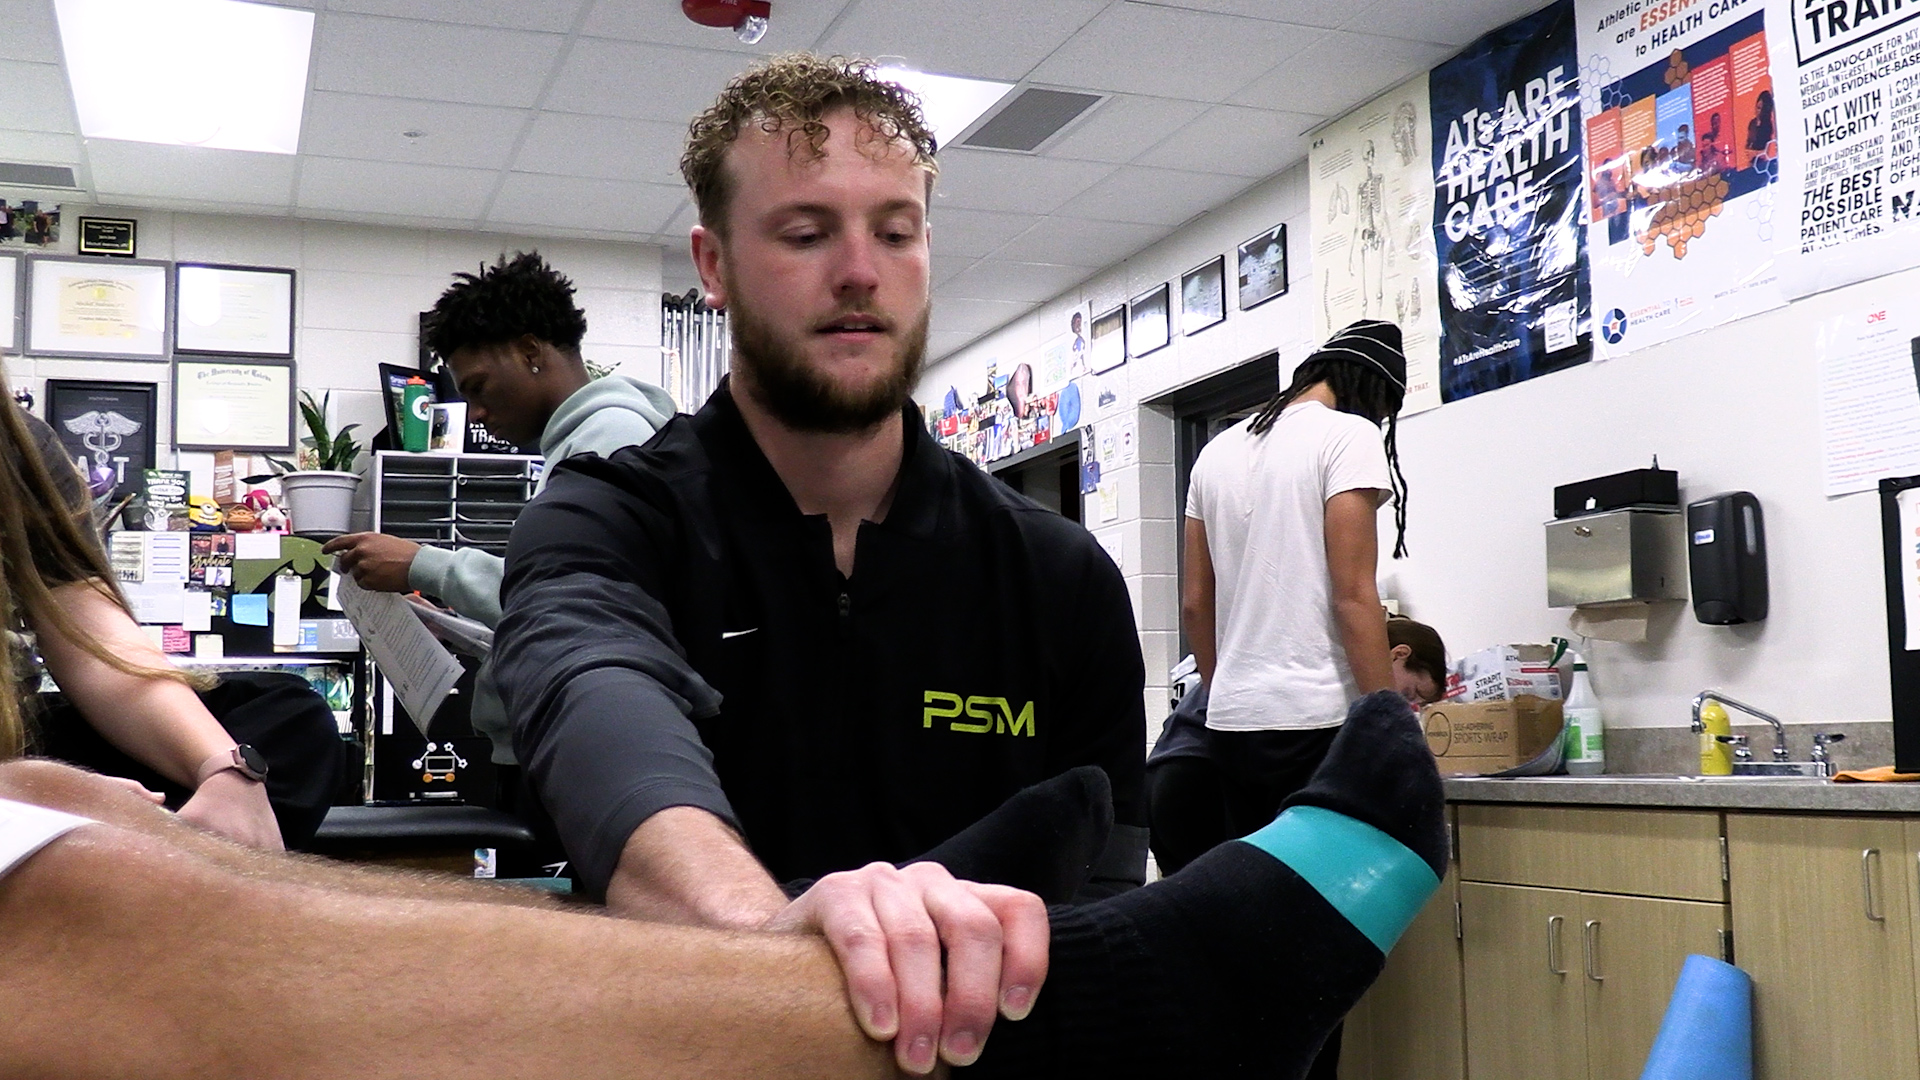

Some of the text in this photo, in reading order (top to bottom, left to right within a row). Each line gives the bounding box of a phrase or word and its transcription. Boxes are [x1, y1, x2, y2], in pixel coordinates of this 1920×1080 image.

[1597, 1, 1642, 33] Athletic
[1615, 26, 1636, 44] are
[1635, 44, 1647, 57] to
[1651, 10, 1703, 50] HEALTH
[1799, 73, 1809, 86] AS
[1810, 66, 1825, 80] THE
[1828, 42, 1884, 74] ADVOCATE
[1886, 35, 1902, 50] FOR
[1800, 78, 1829, 97] MEDICAL
[1876, 49, 1897, 66] MAKE
[1900, 40, 1920, 56] COM
[1895, 71, 1920, 94] COM
[1500, 65, 1568, 136] ARE
[1802, 91, 1826, 109] BASED
[1828, 86, 1839, 98] ON
[1890, 91, 1912, 109] LAWS
[1804, 88, 1882, 136] I ACT WITH
[1890, 101, 1920, 121] GOVERN
[1891, 130, 1906, 143] AND
[1447, 109, 1570, 204] HEALTH
[1891, 139, 1913, 158] AND
[1811, 153, 1832, 168] FULLY
[1803, 165, 1884, 207] THE BEST
[1889, 169, 1906, 184] OF
[1444, 170, 1537, 243] CARE
[1801, 186, 1883, 226] POSSIBLE
[1800, 205, 1883, 240] PATIENT CARE
[1630, 308, 1671, 326] HEALTH CARE
[1473, 682, 1504, 700] ATHLETIC
[1475, 672, 1501, 689] STRAPIT
[923, 690, 1035, 737] PSM
[1454, 731, 1485, 744] SPORTS
[1485, 731, 1509, 743] WRAP
